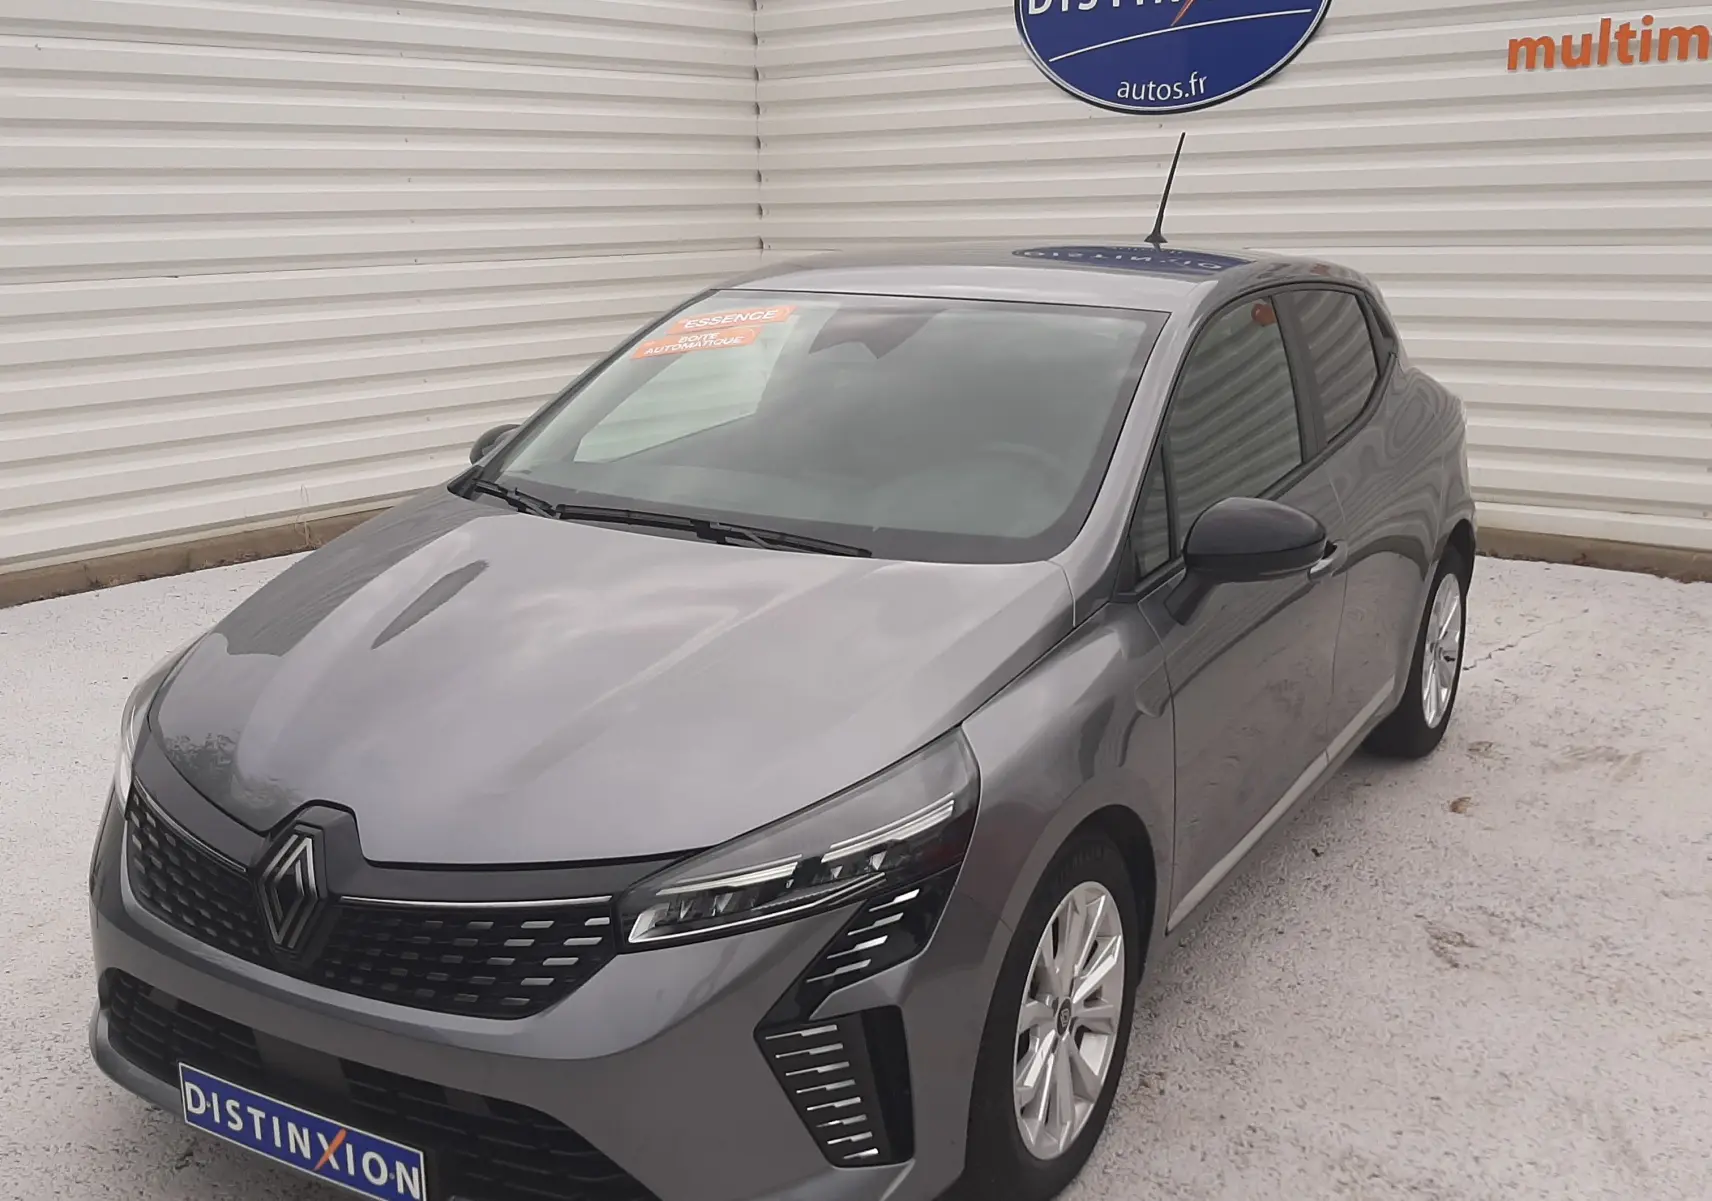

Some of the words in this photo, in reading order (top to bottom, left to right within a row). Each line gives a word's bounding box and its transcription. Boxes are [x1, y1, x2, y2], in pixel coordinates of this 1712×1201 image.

[1507, 15, 1711, 71] multim
[1117, 71, 1207, 101] autos.fr
[684, 309, 778, 328] ESSENCE
[643, 336, 745, 355] AUTOMATIQUE
[184, 1081, 421, 1200] DISTINXION
